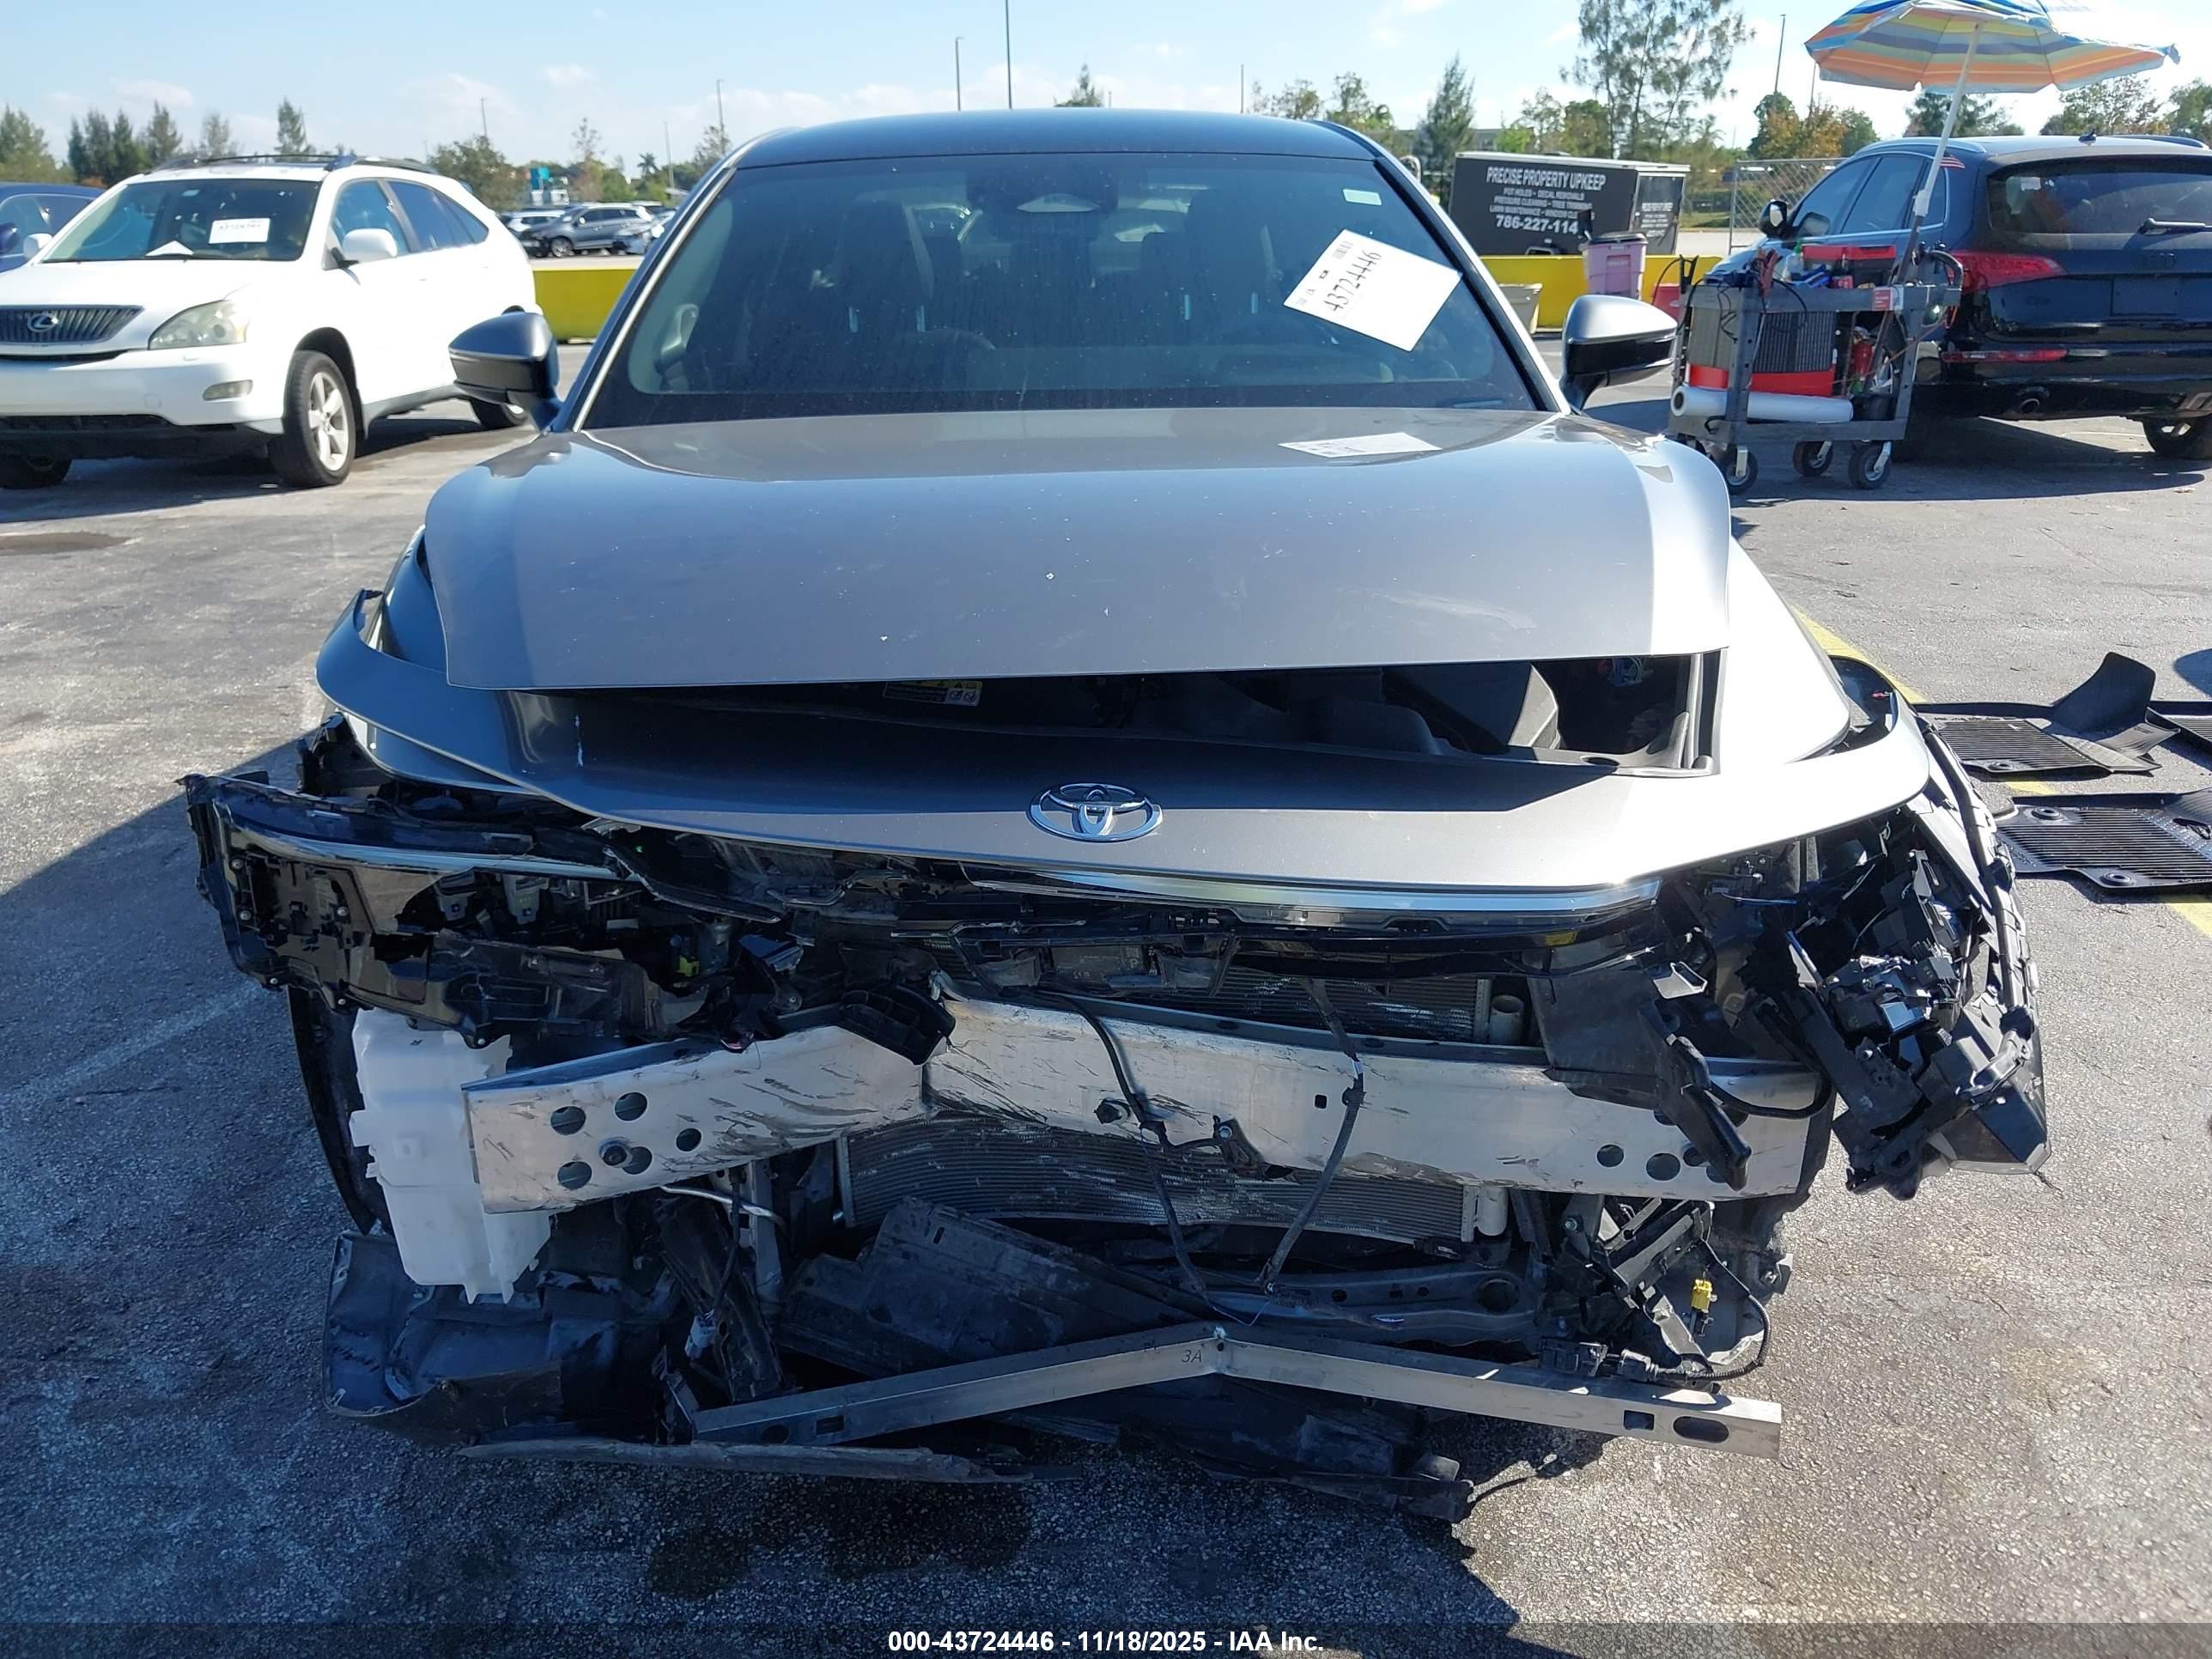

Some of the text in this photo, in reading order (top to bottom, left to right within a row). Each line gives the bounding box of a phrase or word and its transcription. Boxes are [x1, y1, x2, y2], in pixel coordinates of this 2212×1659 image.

[1486, 166, 1607, 191] PRECISE PROPERTY UPKEEP
[1496, 214, 1579, 234] 786-227-114
[1323, 249, 1382, 312] 43724446
[1181, 1349, 1202, 1364] 3A
